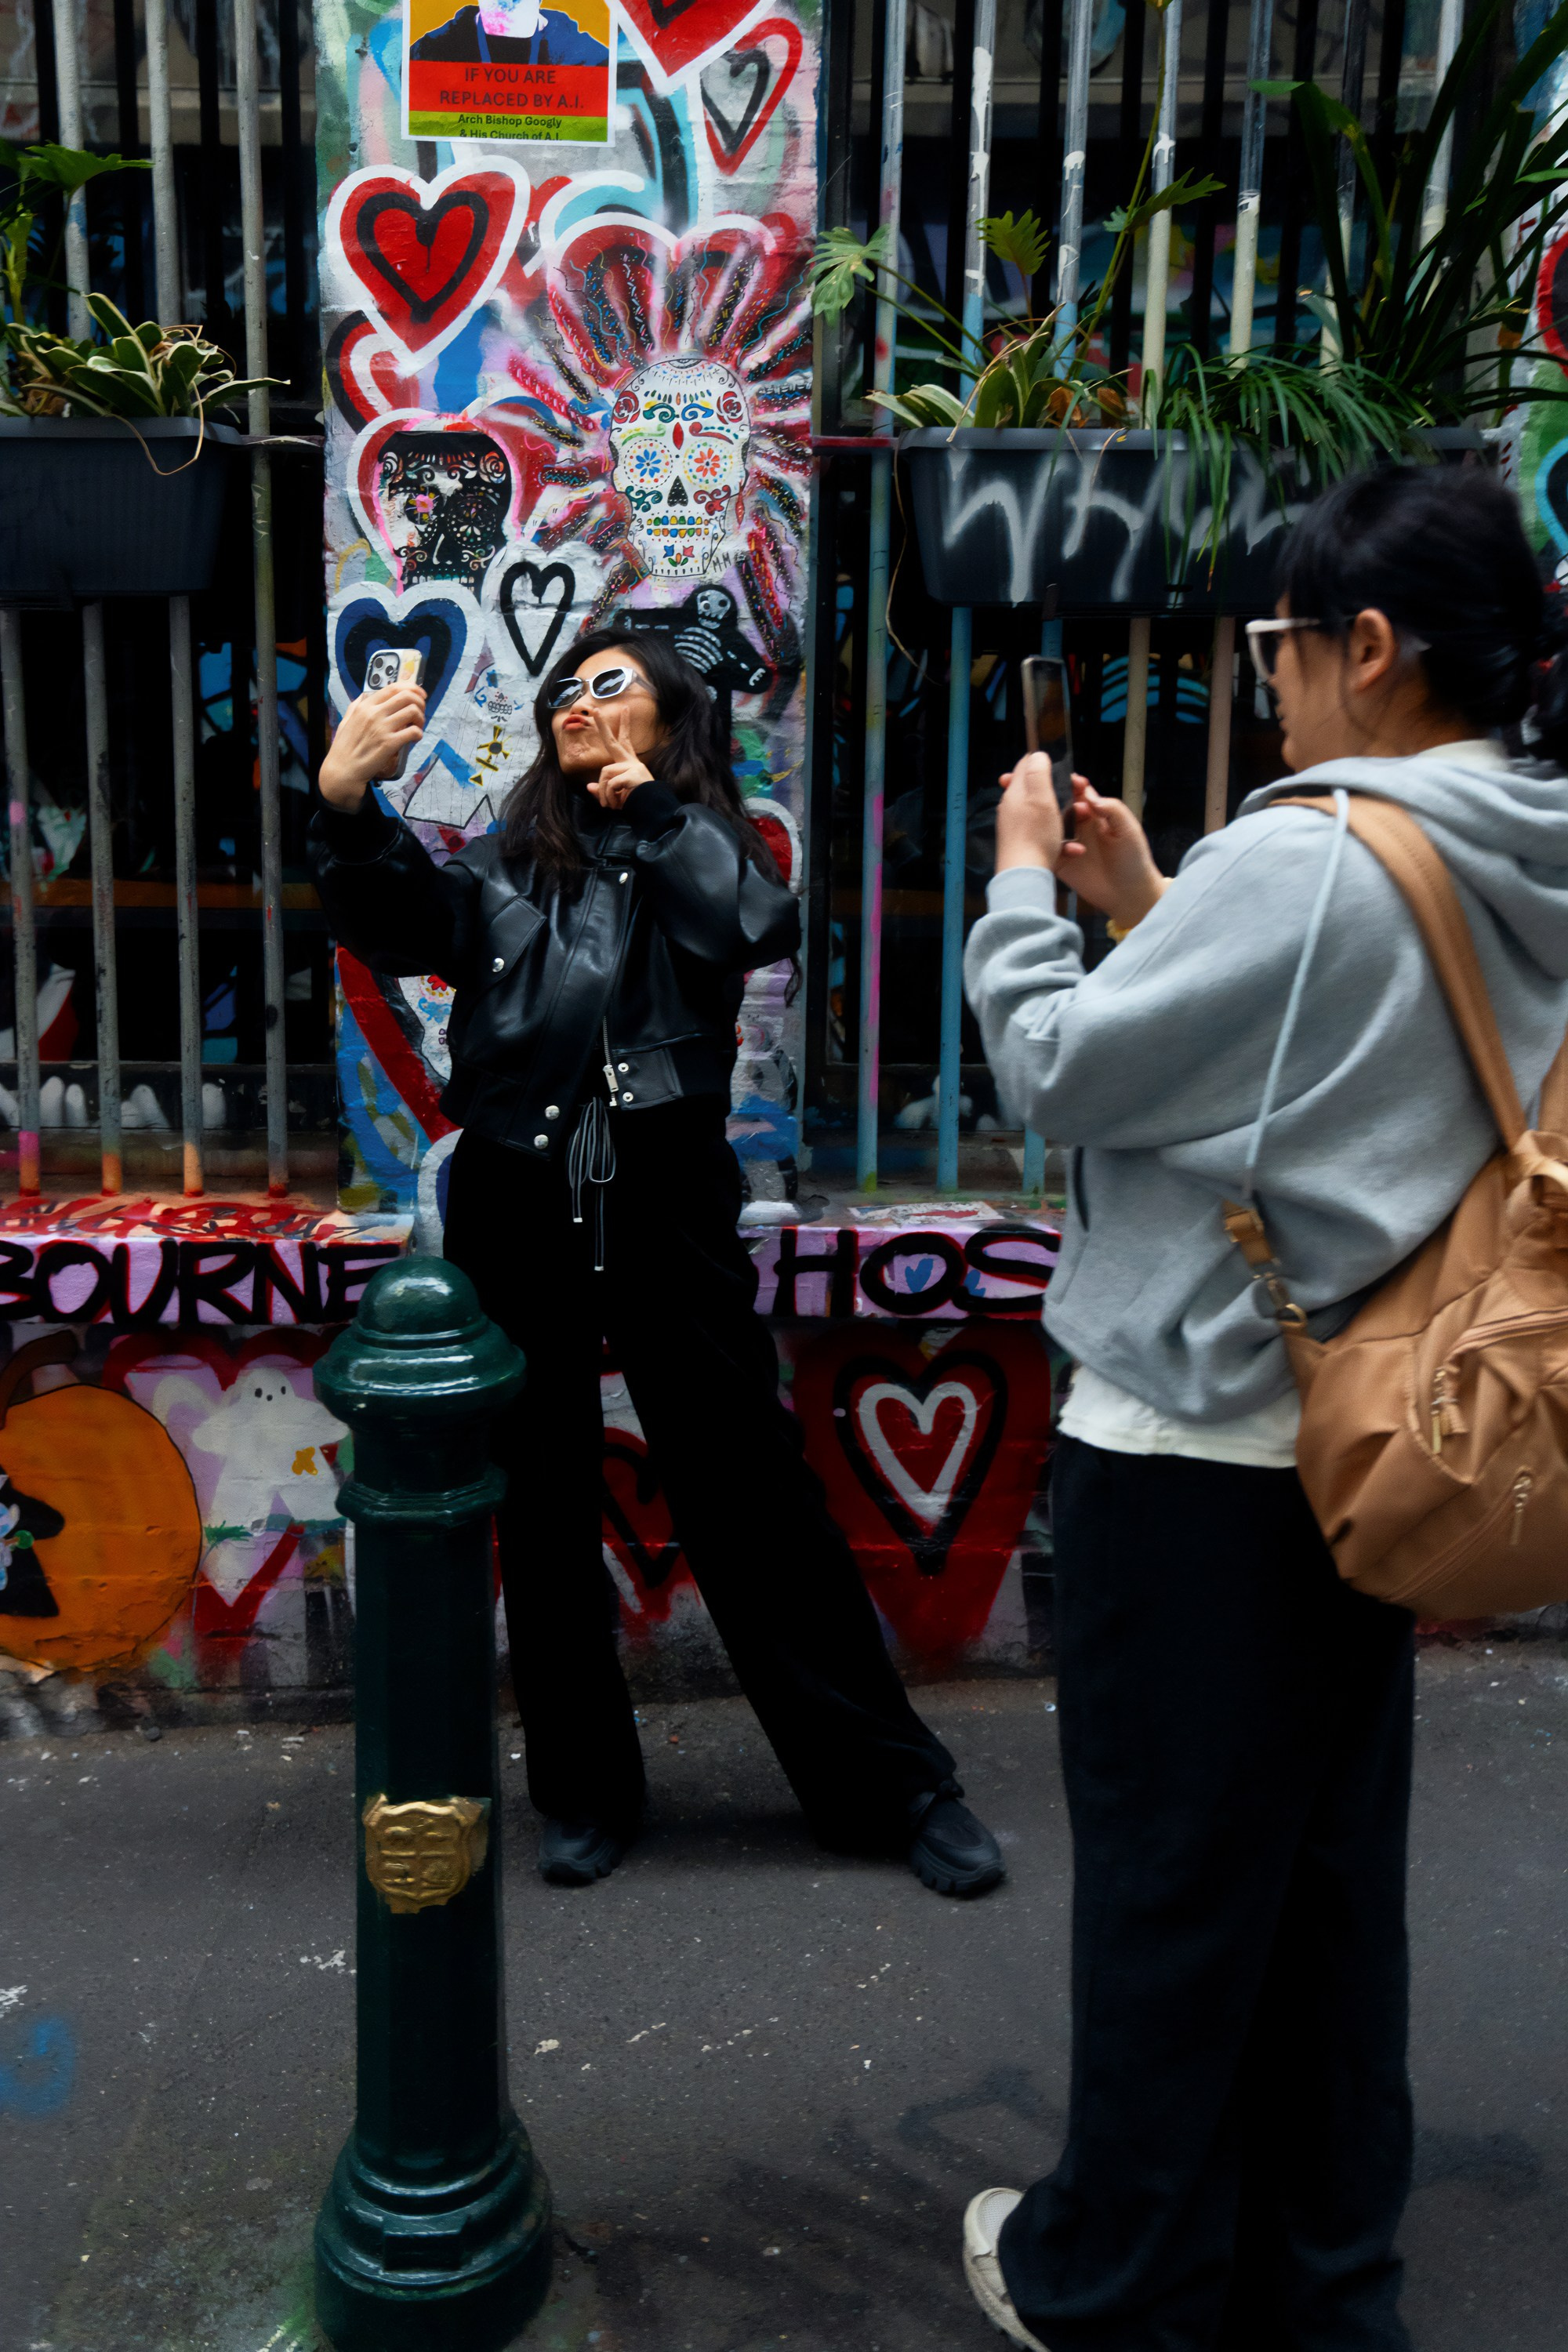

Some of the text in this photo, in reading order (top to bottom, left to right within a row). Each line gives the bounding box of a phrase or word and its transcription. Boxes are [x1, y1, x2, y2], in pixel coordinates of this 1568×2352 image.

[465, 68, 556, 84] IF YOU ARE
[440, 90, 584, 108] REPLACED BY A.I.
[458, 114, 562, 129] Arch Bishop Googly
[459, 129, 467, 138] &
[470, 129, 488, 138] His
[490, 130, 529, 140] Church
[532, 132, 543, 140] of
